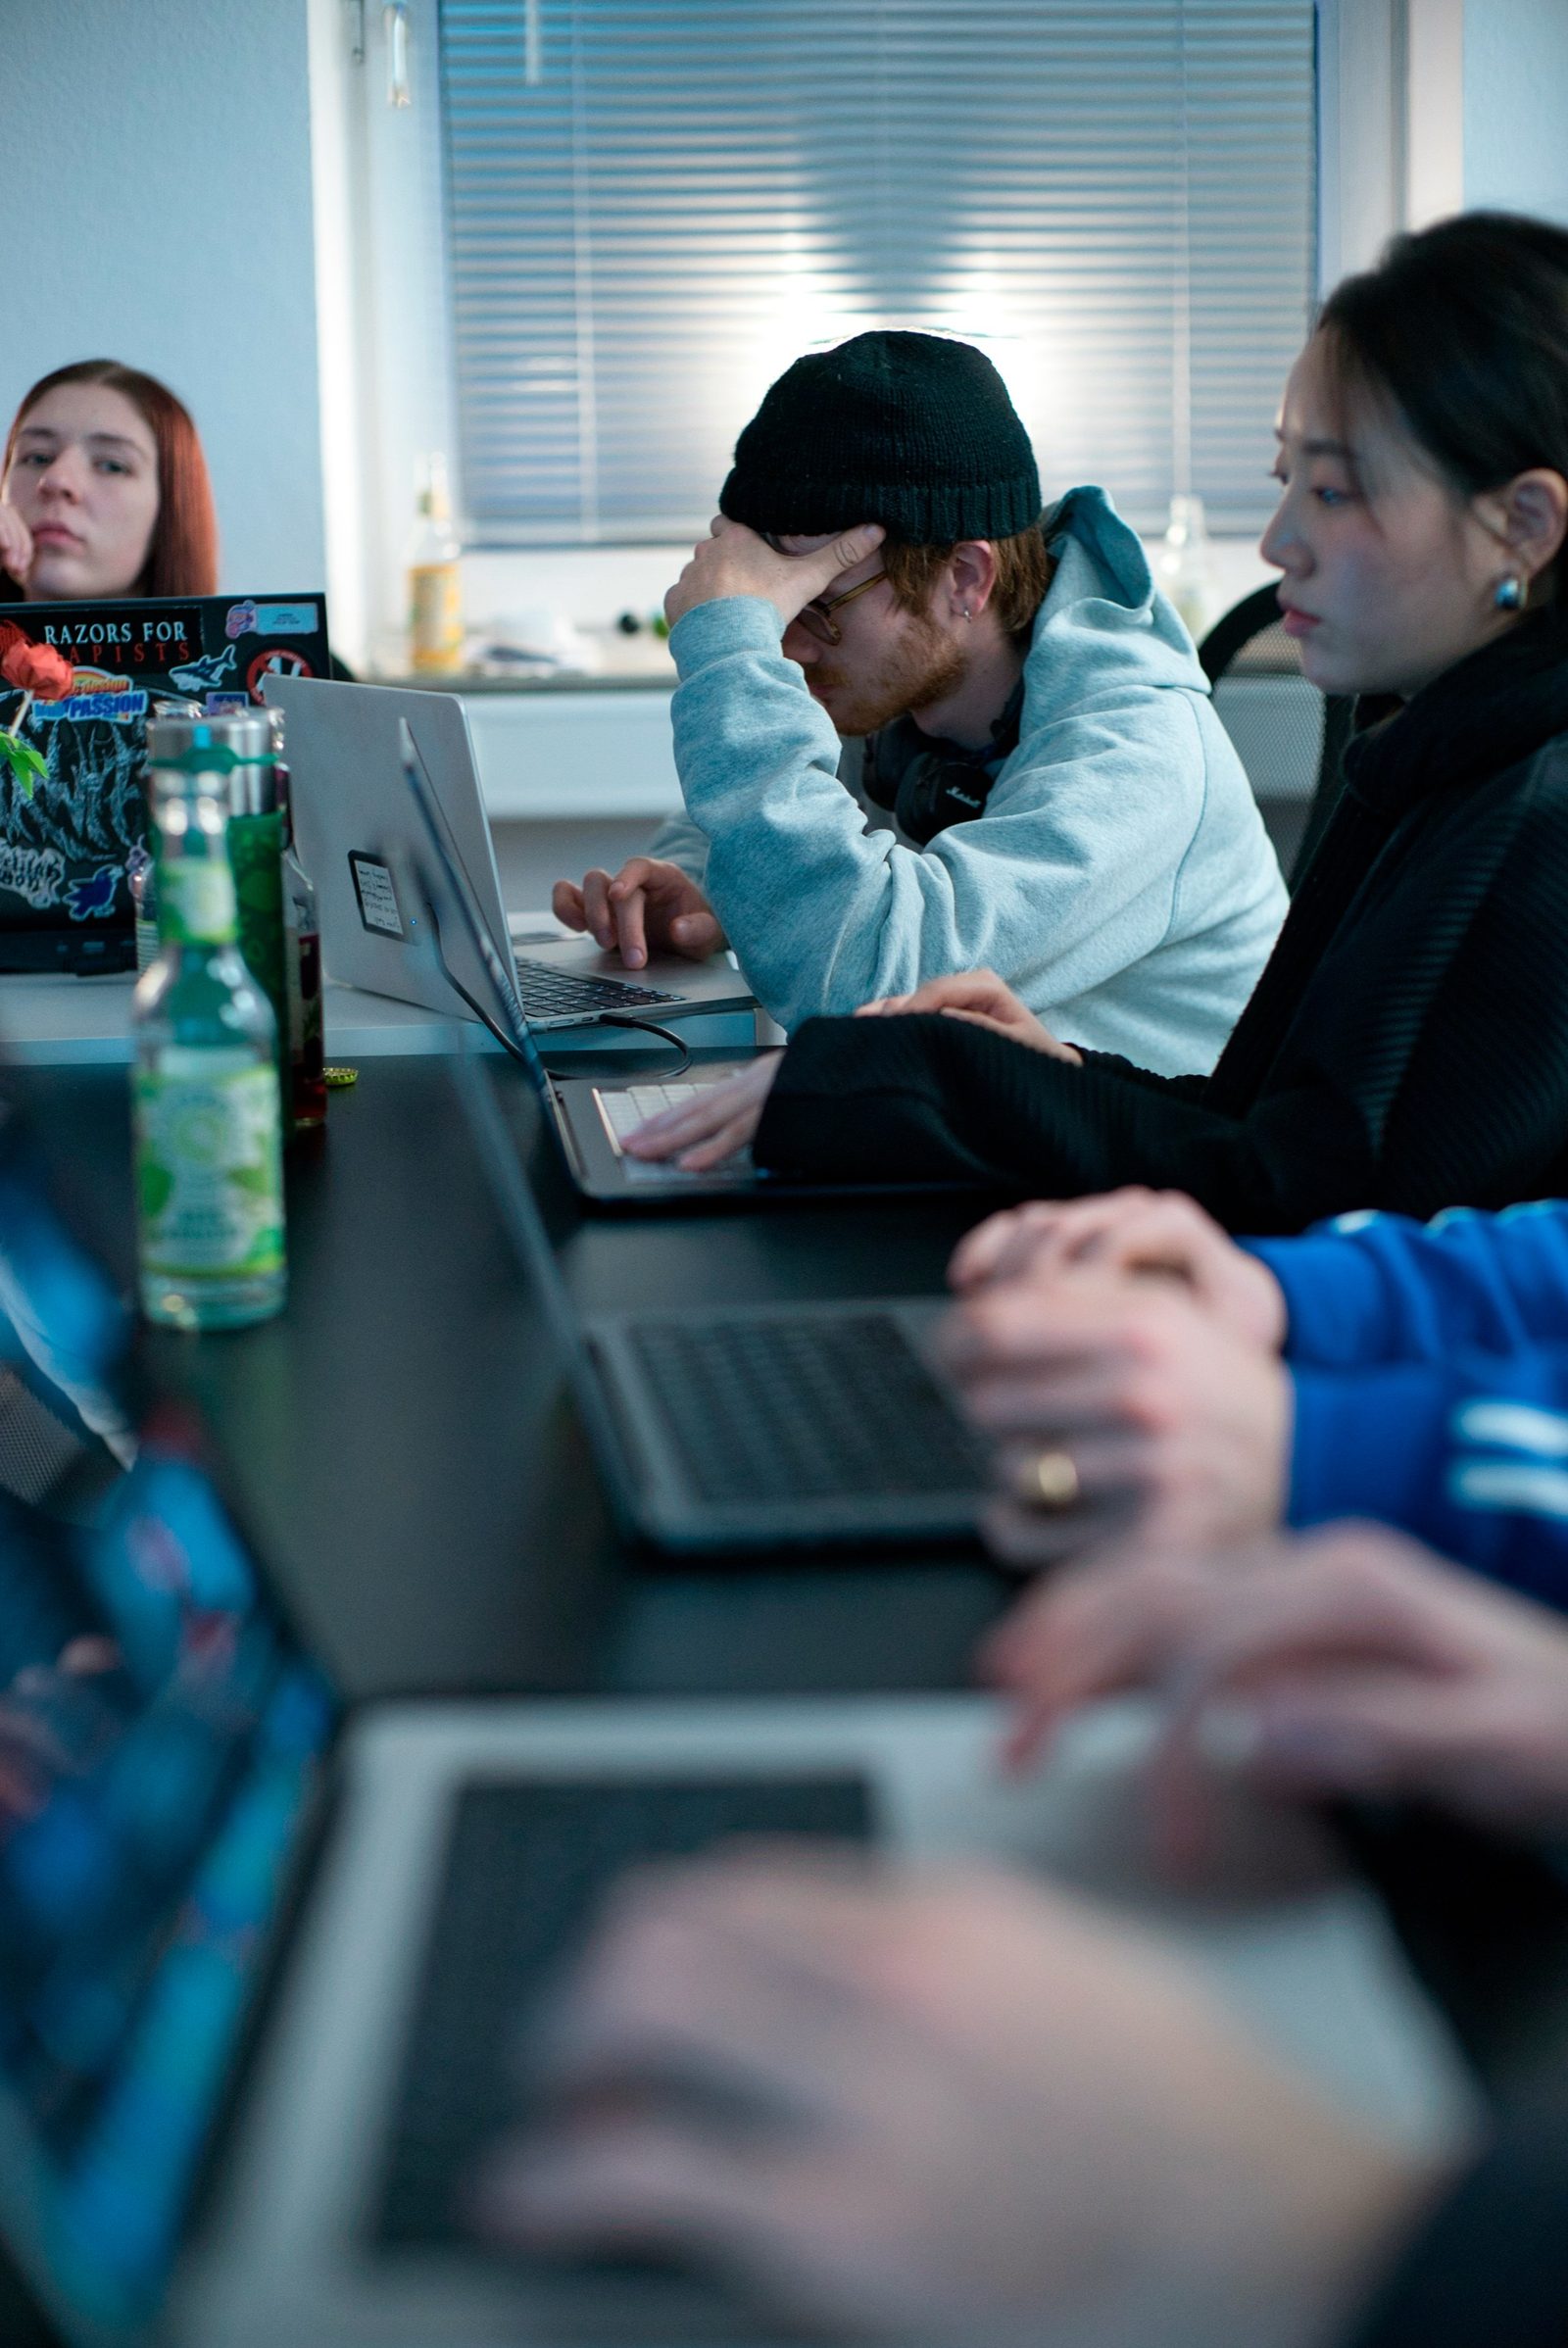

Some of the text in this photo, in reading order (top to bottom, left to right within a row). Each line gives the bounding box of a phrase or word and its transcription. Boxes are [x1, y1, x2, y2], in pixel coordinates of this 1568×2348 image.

[44, 620, 187, 644] RAZORS FOR
[70, 642, 190, 662] APISTS
[70, 693, 144, 717] PASSION
